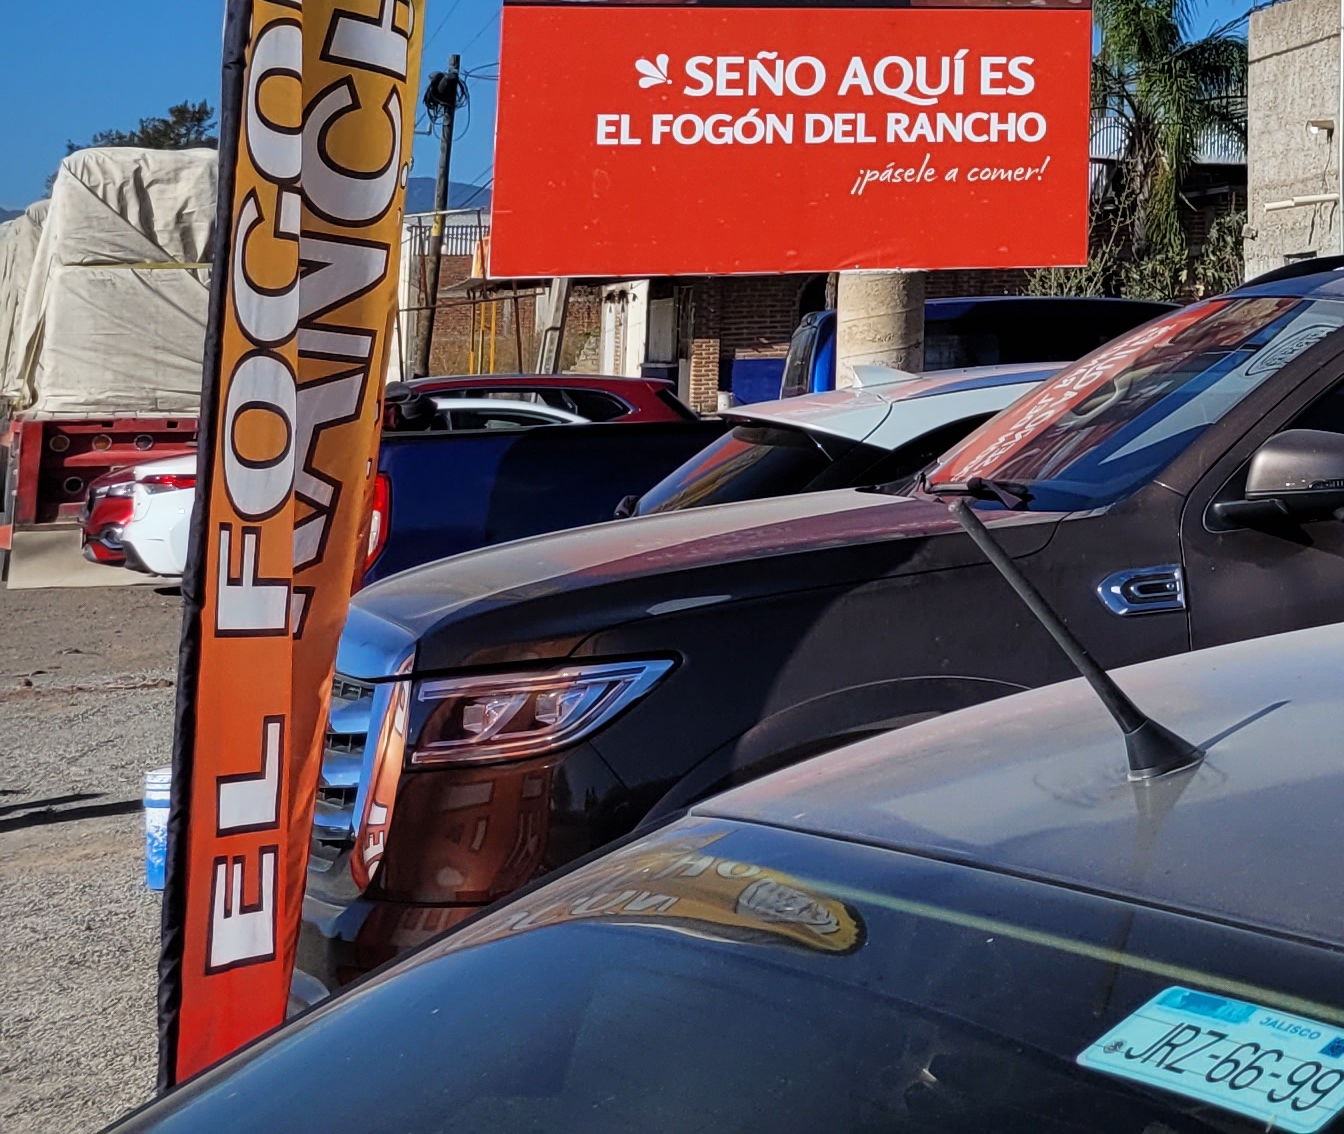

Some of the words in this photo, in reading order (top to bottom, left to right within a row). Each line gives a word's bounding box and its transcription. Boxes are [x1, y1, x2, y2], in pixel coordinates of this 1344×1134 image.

[683, 50, 827, 97] SEÑO
[837, 48, 970, 106] AQUÍ
[980, 55, 1035, 96] ES
[596, 113, 642, 146] EL
[651, 108, 794, 145] FOGÓN
[804, 112, 877, 144] DEL
[886, 111, 1047, 144] RANCHO
[850, 153, 938, 195] ¡pásele
[944, 166, 957, 182] a
[966, 155, 1051, 182] comer!
[204, 714, 286, 976] EL
[1259, 1016, 1322, 1041] JALISCO
